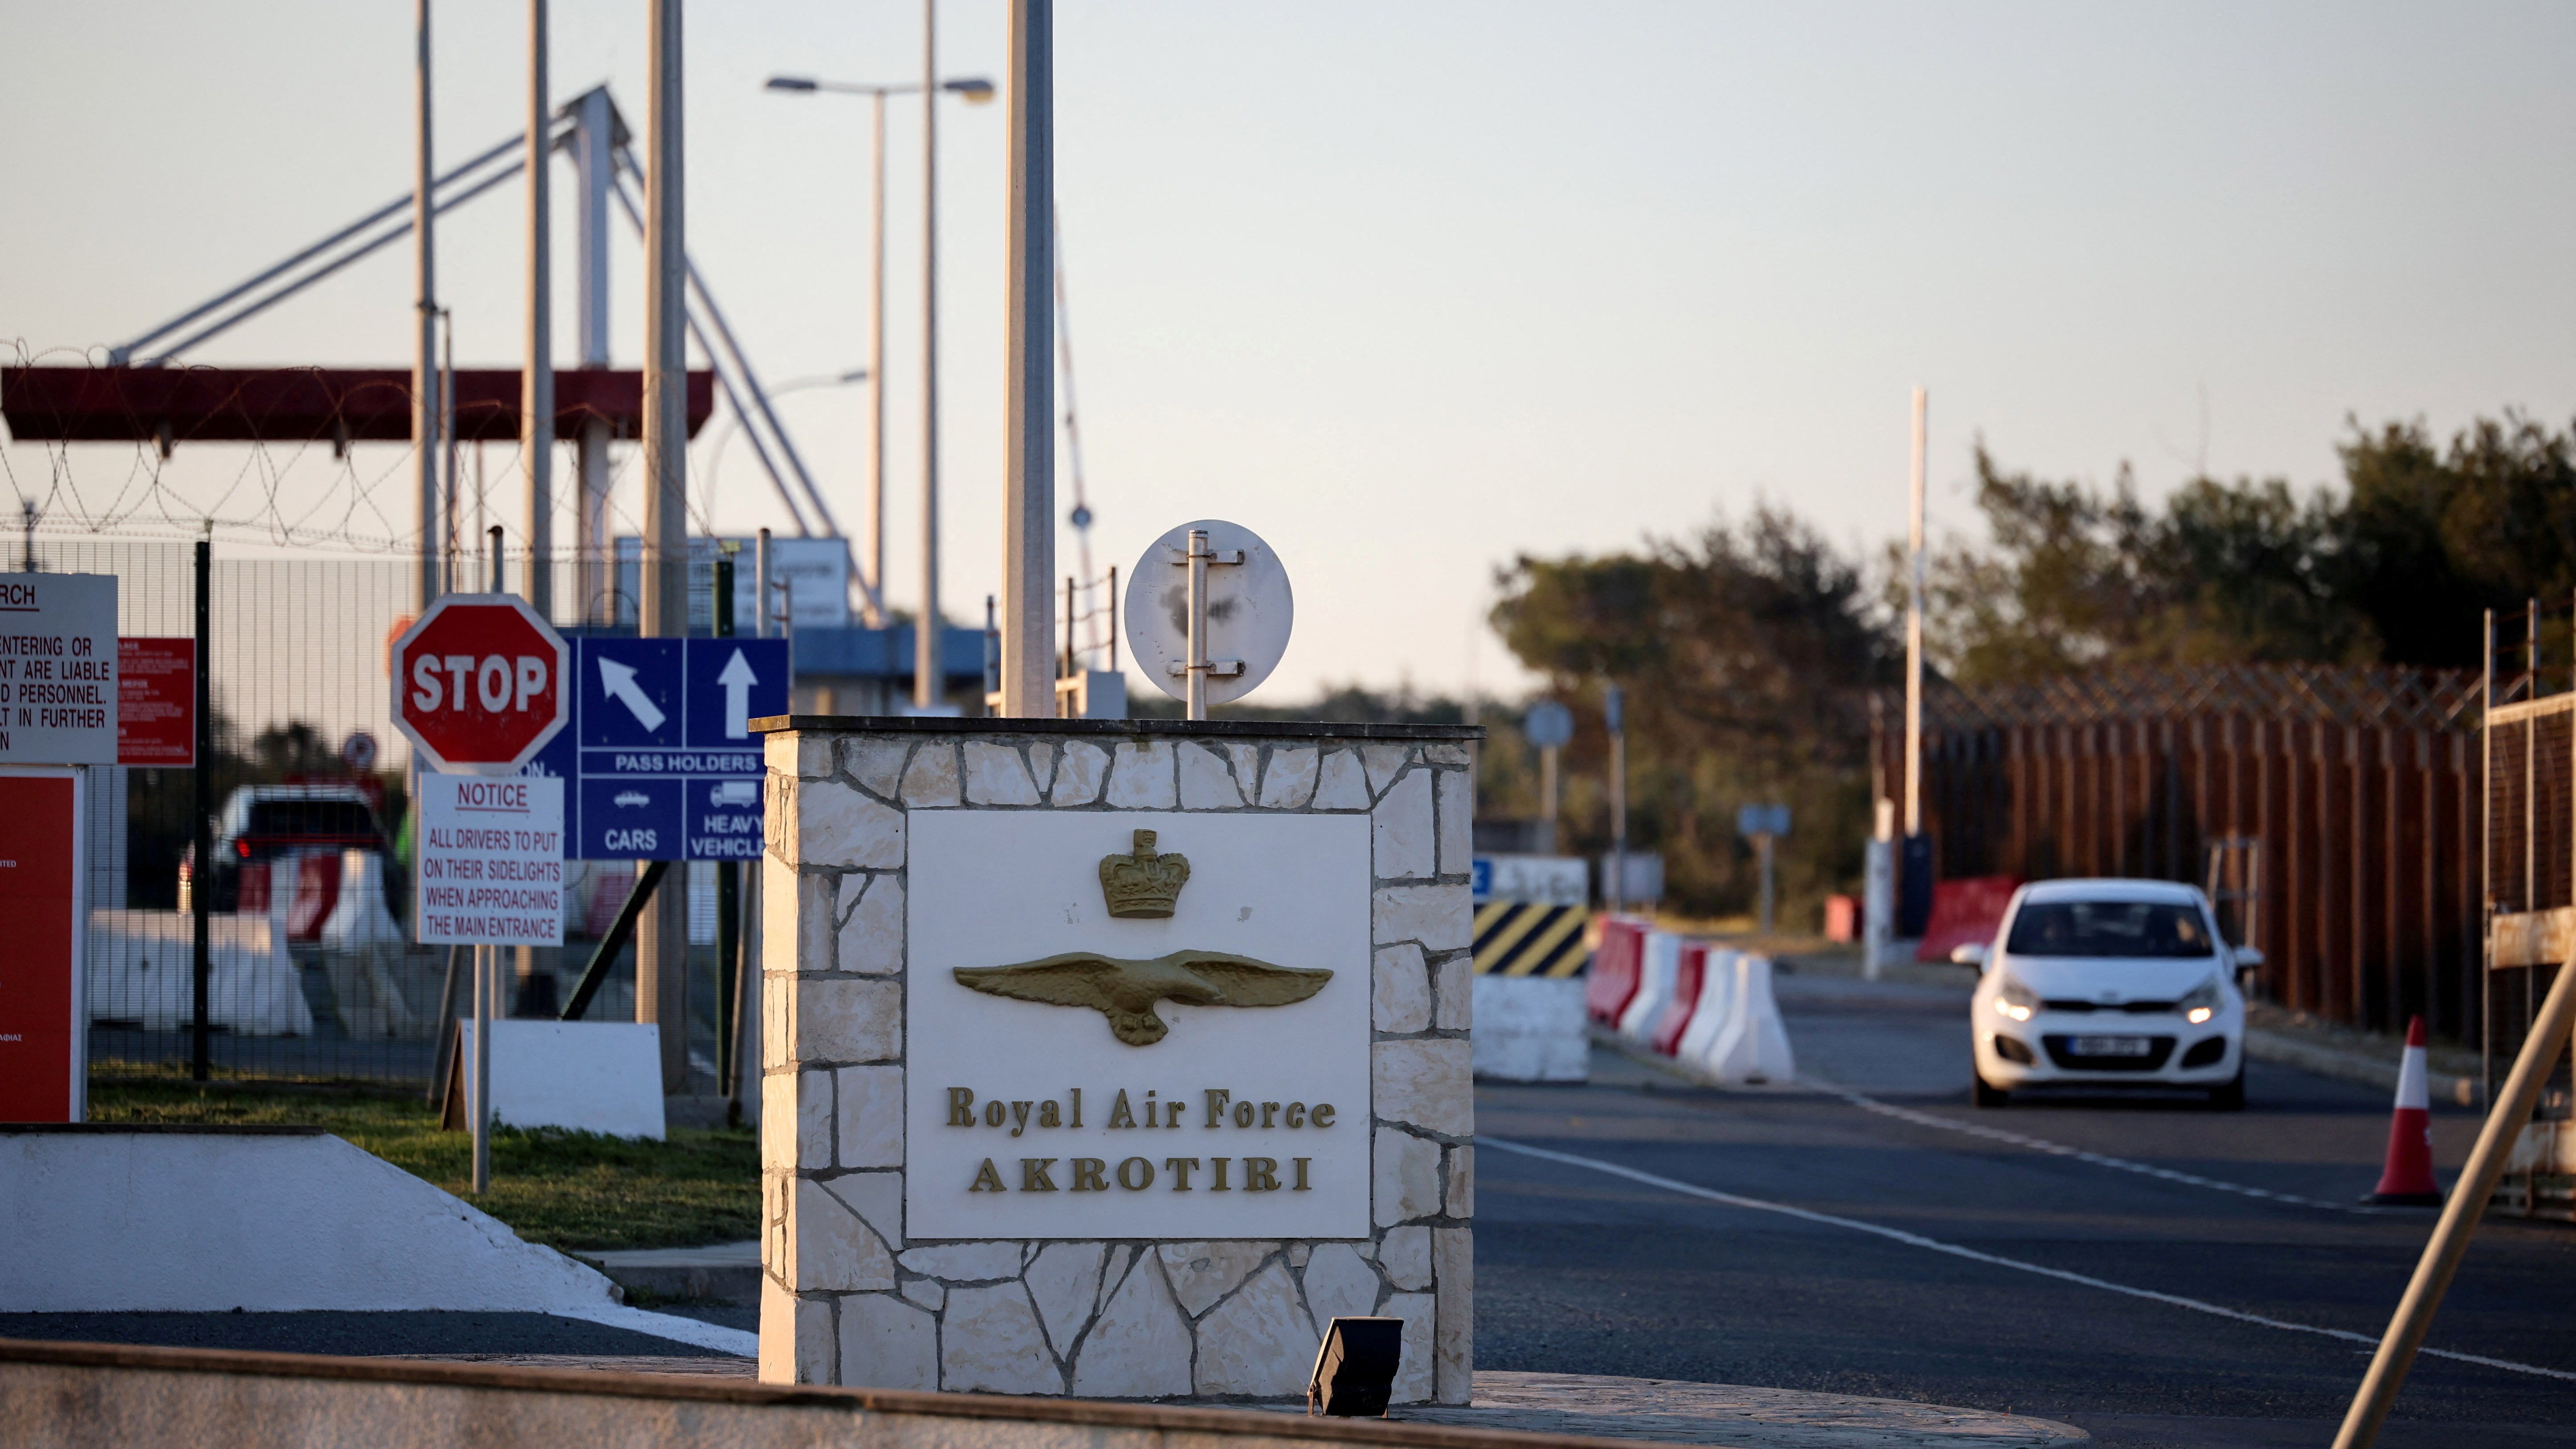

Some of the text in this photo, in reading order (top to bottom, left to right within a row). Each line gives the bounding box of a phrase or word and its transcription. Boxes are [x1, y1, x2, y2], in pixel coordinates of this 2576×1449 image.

[0, 635, 92, 656] NTERING OR
[24, 660, 52, 680] ARE
[62, 661, 109, 681] LIABLE
[20, 684, 106, 704] PERSONNEL.
[412, 653, 547, 713] STOP
[19, 708, 32, 727] IN
[41, 709, 105, 728] FURTHER
[615, 755, 757, 771] PASS HOLDERS
[458, 783, 527, 807] NOTICE
[704, 815, 764, 834] HEAVY
[429, 828, 557, 852] ALL DRIVERS TO PUT
[605, 829, 657, 851] CARS
[425, 858, 560, 882] ON THEIR SIDELIGHTS
[426, 887, 558, 910] WHEN APPROACHING
[428, 915, 555, 939] THE MAIN ENTRANCE
[947, 1087, 1336, 1137] Royal Air Force
[968, 1156, 1312, 1192] AKROTIRI
